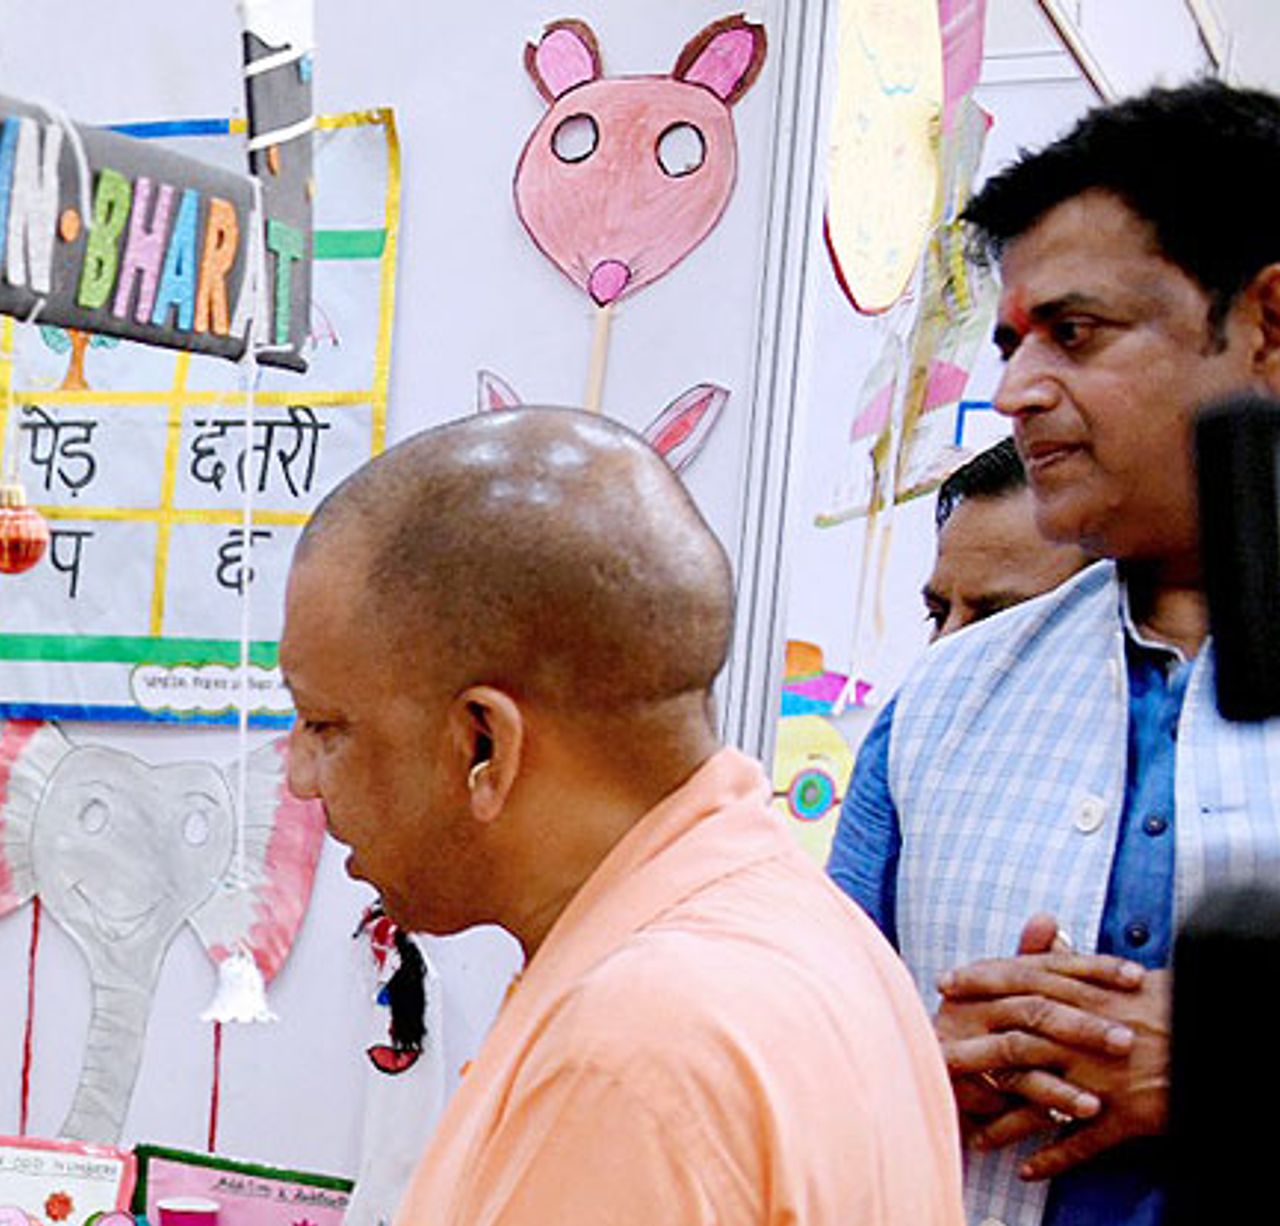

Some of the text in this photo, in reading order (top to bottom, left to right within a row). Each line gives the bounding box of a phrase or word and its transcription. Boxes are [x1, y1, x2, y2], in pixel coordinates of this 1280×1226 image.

[77, 167, 304, 347] BHARAT
[20, 405, 98, 497] पेड़
[191, 405, 330, 497] छतरी
[50, 530, 93, 598] प
